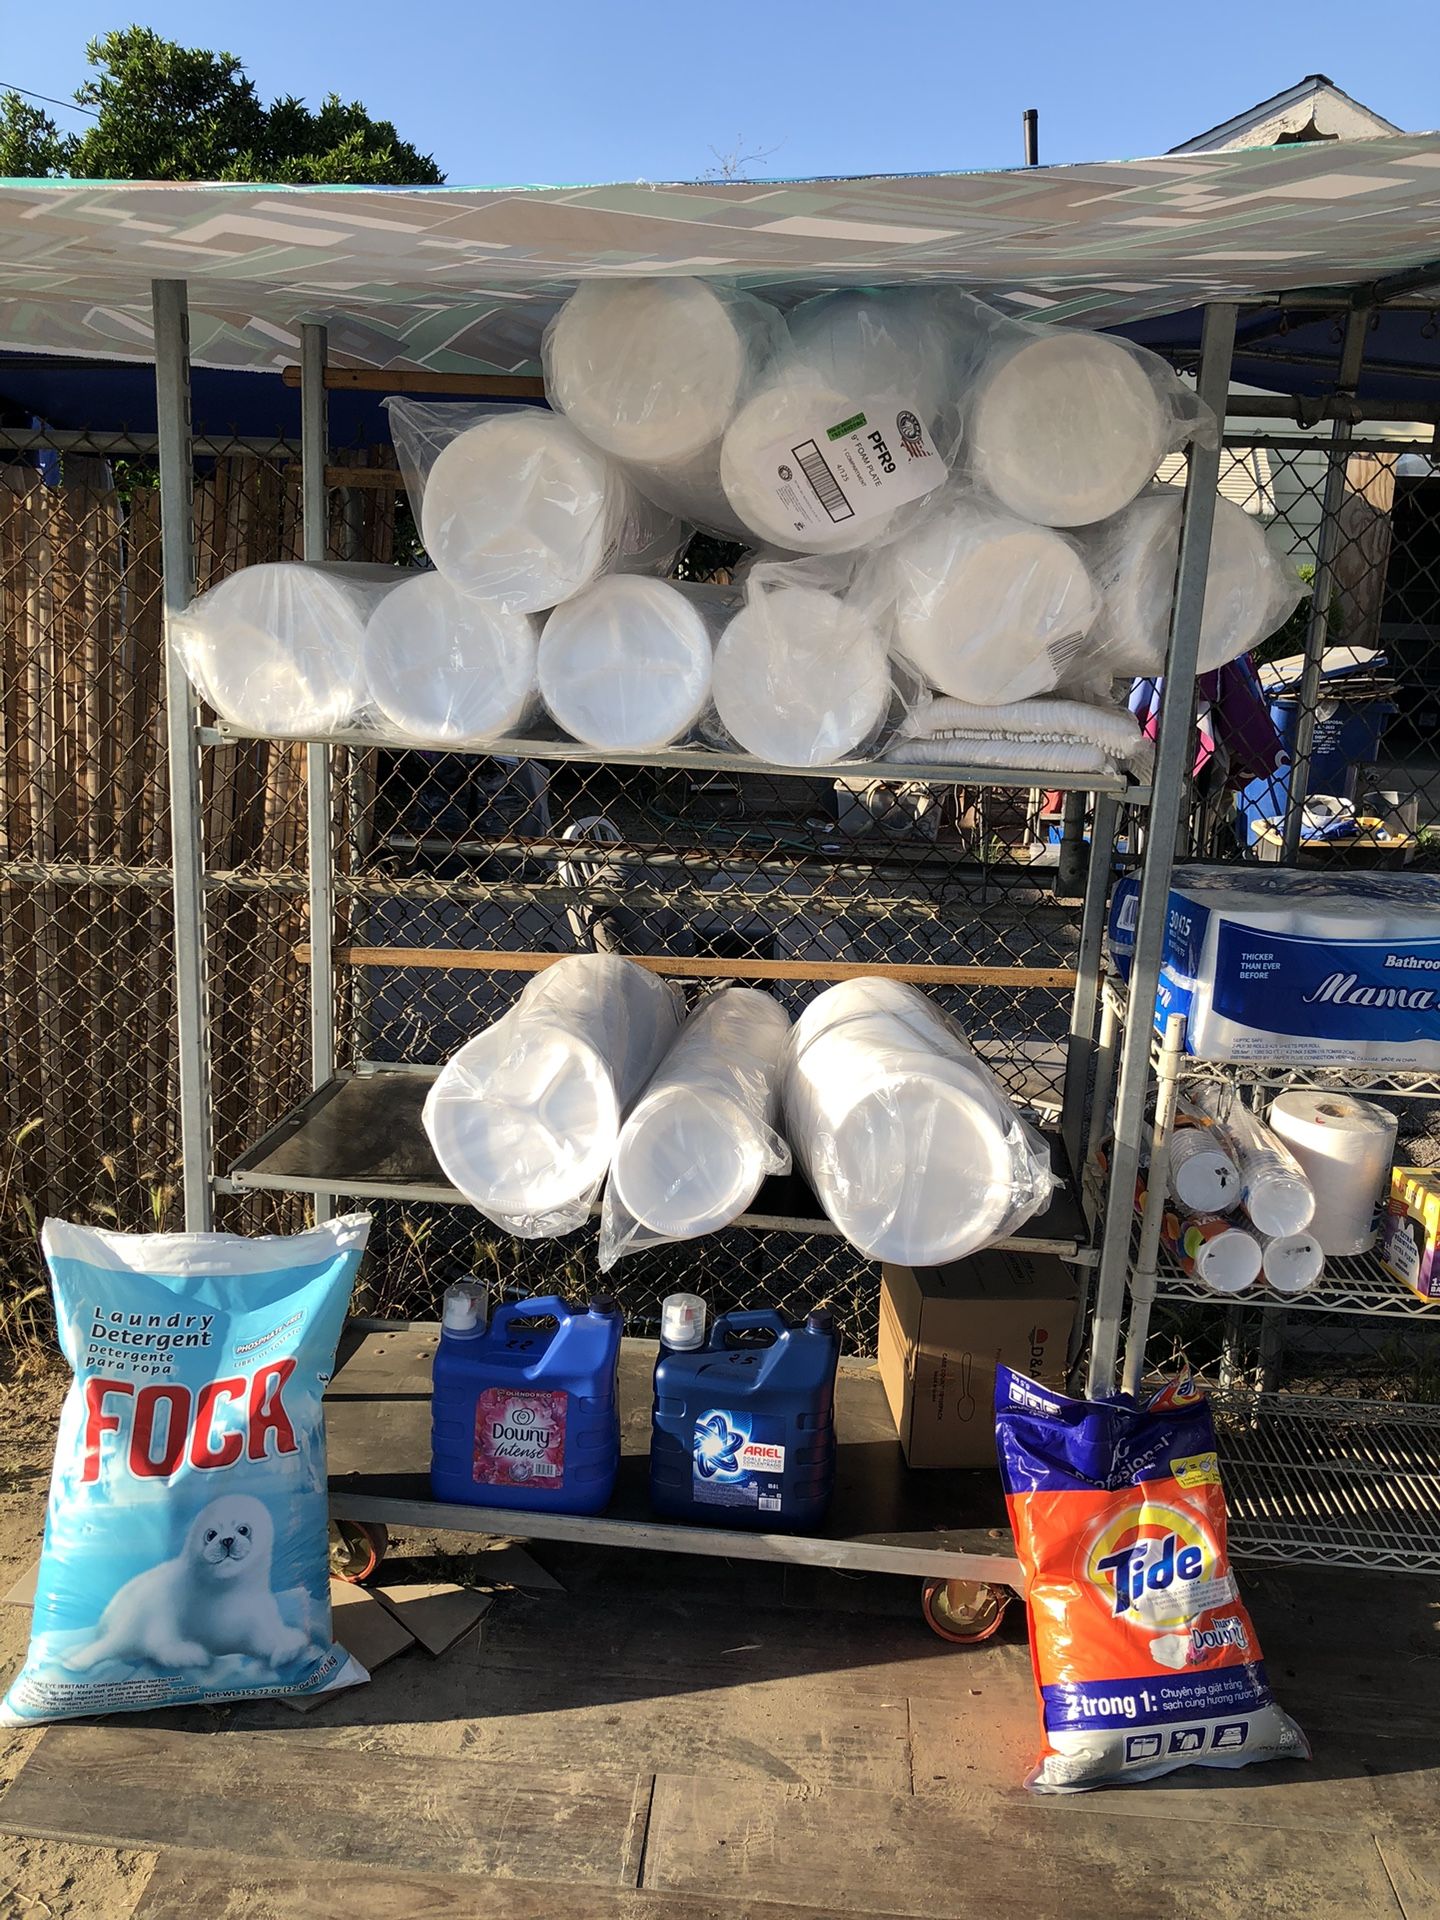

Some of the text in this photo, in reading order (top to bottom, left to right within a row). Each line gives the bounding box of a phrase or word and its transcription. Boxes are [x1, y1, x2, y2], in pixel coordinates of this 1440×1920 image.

[866, 430, 896, 474] PFR9
[845, 452, 868, 488] COMPARTMENT
[855, 442, 870, 466] FOAM
[867, 465, 882, 488] PLATE
[1303, 973, 1434, 1010] Mama
[95, 1307, 213, 1330] Laundry
[92, 1324, 211, 1351] Detergent
[86, 1356, 171, 1375] para ropa
[89, 1344, 174, 1362] Detergente
[729, 1353, 757, 1365] 25
[1029, 1346, 1044, 1379] D&A
[80, 1358, 299, 1483] FOCA
[492, 1422, 550, 1449] Downy
[494, 1442, 545, 1459] Intense
[744, 1446, 782, 1459] ARIEL
[1097, 1535, 1203, 1614] Tide
[1192, 1627, 1246, 1649] Downy
[320, 1665, 329, 1676] 10
[328, 1656, 338, 1669] kg
[1081, 1695, 1137, 1719] trong
[1140, 1691, 1157, 1712] 1:
[1160, 1686, 1193, 1699] Chuyên
[1194, 1686, 1207, 1696] gia
[1163, 1699, 1183, 1711] sạch
[1185, 1697, 1206, 1710] cùng
[1207, 1692, 1234, 1705] hương
